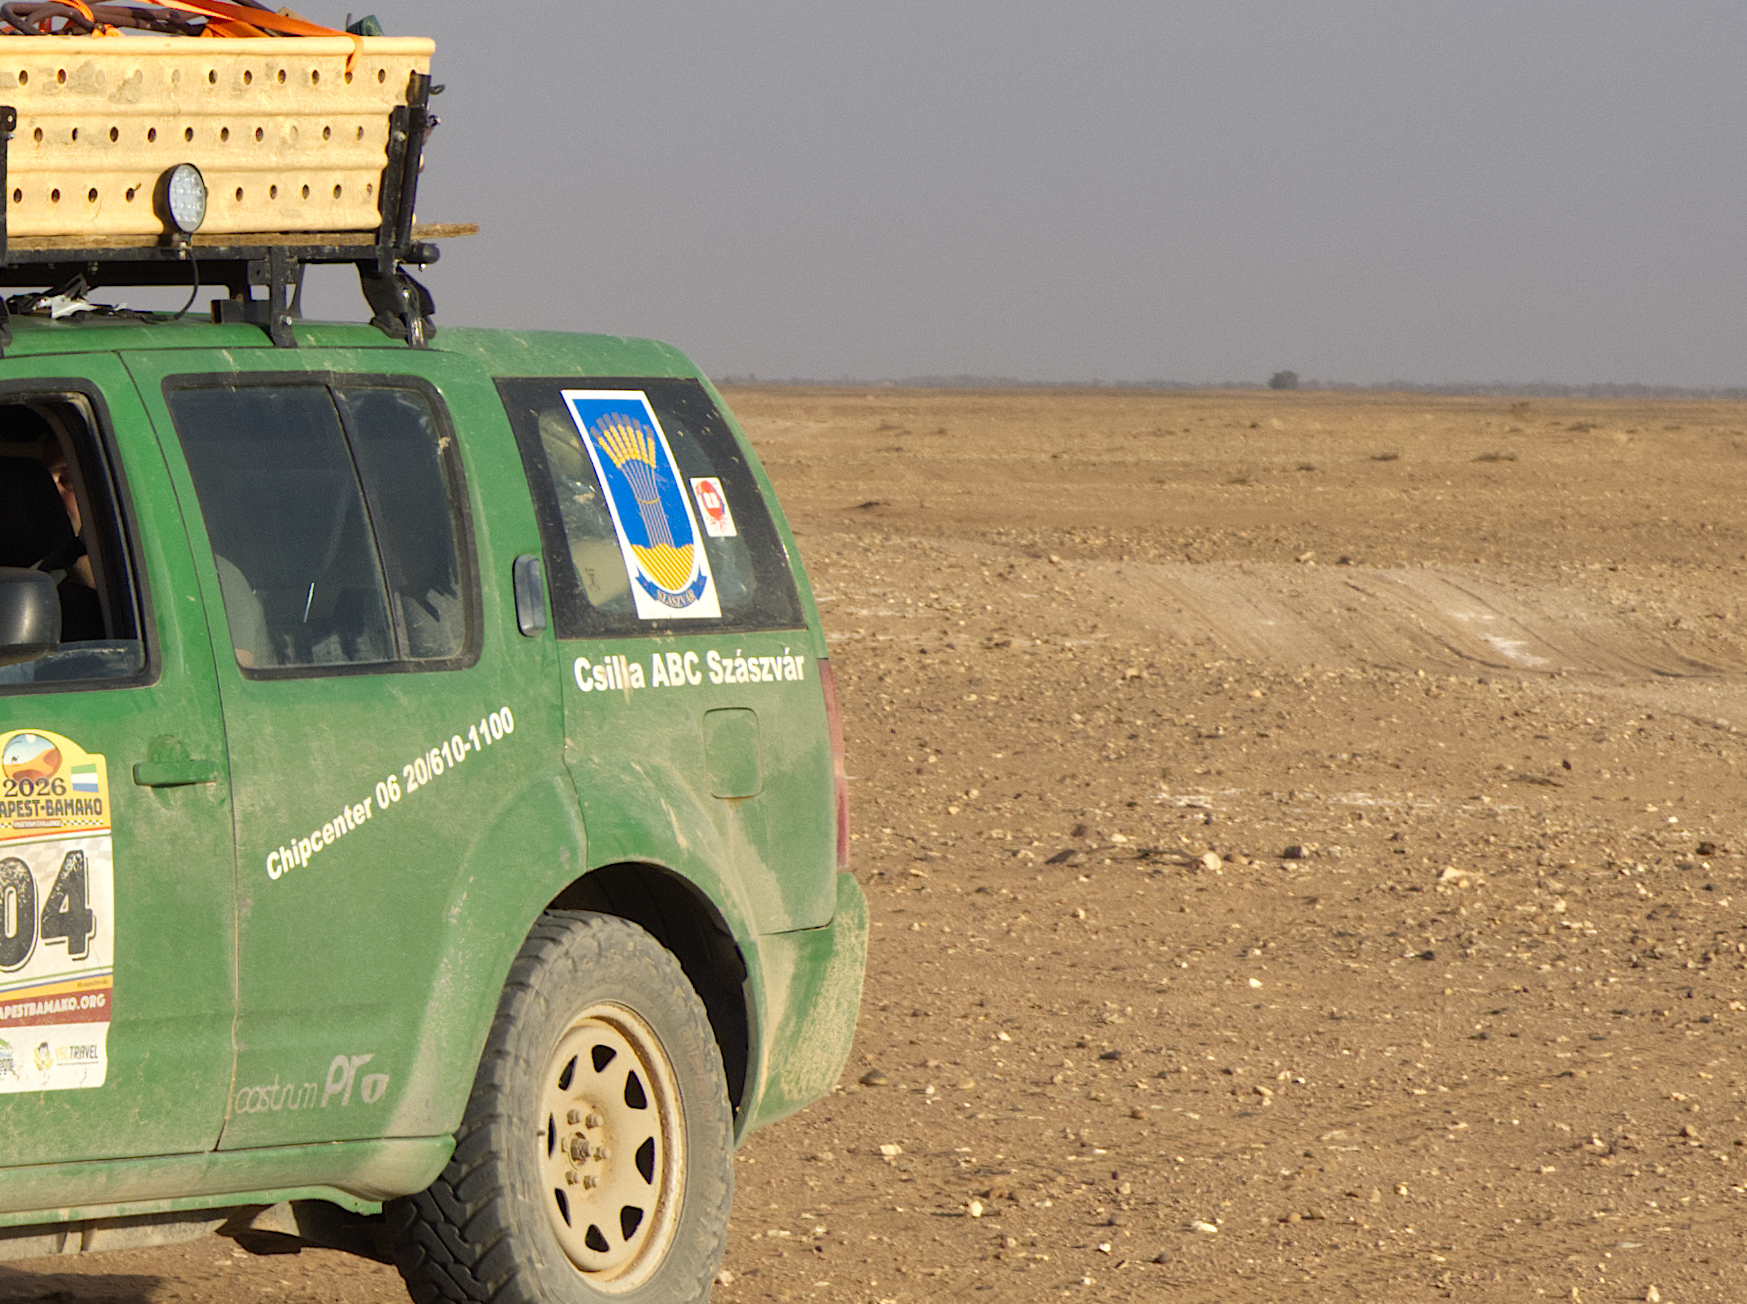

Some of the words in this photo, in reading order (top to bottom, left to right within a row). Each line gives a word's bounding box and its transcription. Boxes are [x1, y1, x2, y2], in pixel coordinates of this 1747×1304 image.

[573, 654, 646, 692] Csilla
[652, 651, 702, 688] ABC
[706, 646, 805, 685] Szászvár
[3, 777, 67, 798] 2026
[266, 795, 372, 880] Chipcenter
[375, 774, 401, 810] 06
[403, 705, 515, 794] 20/610-1100
